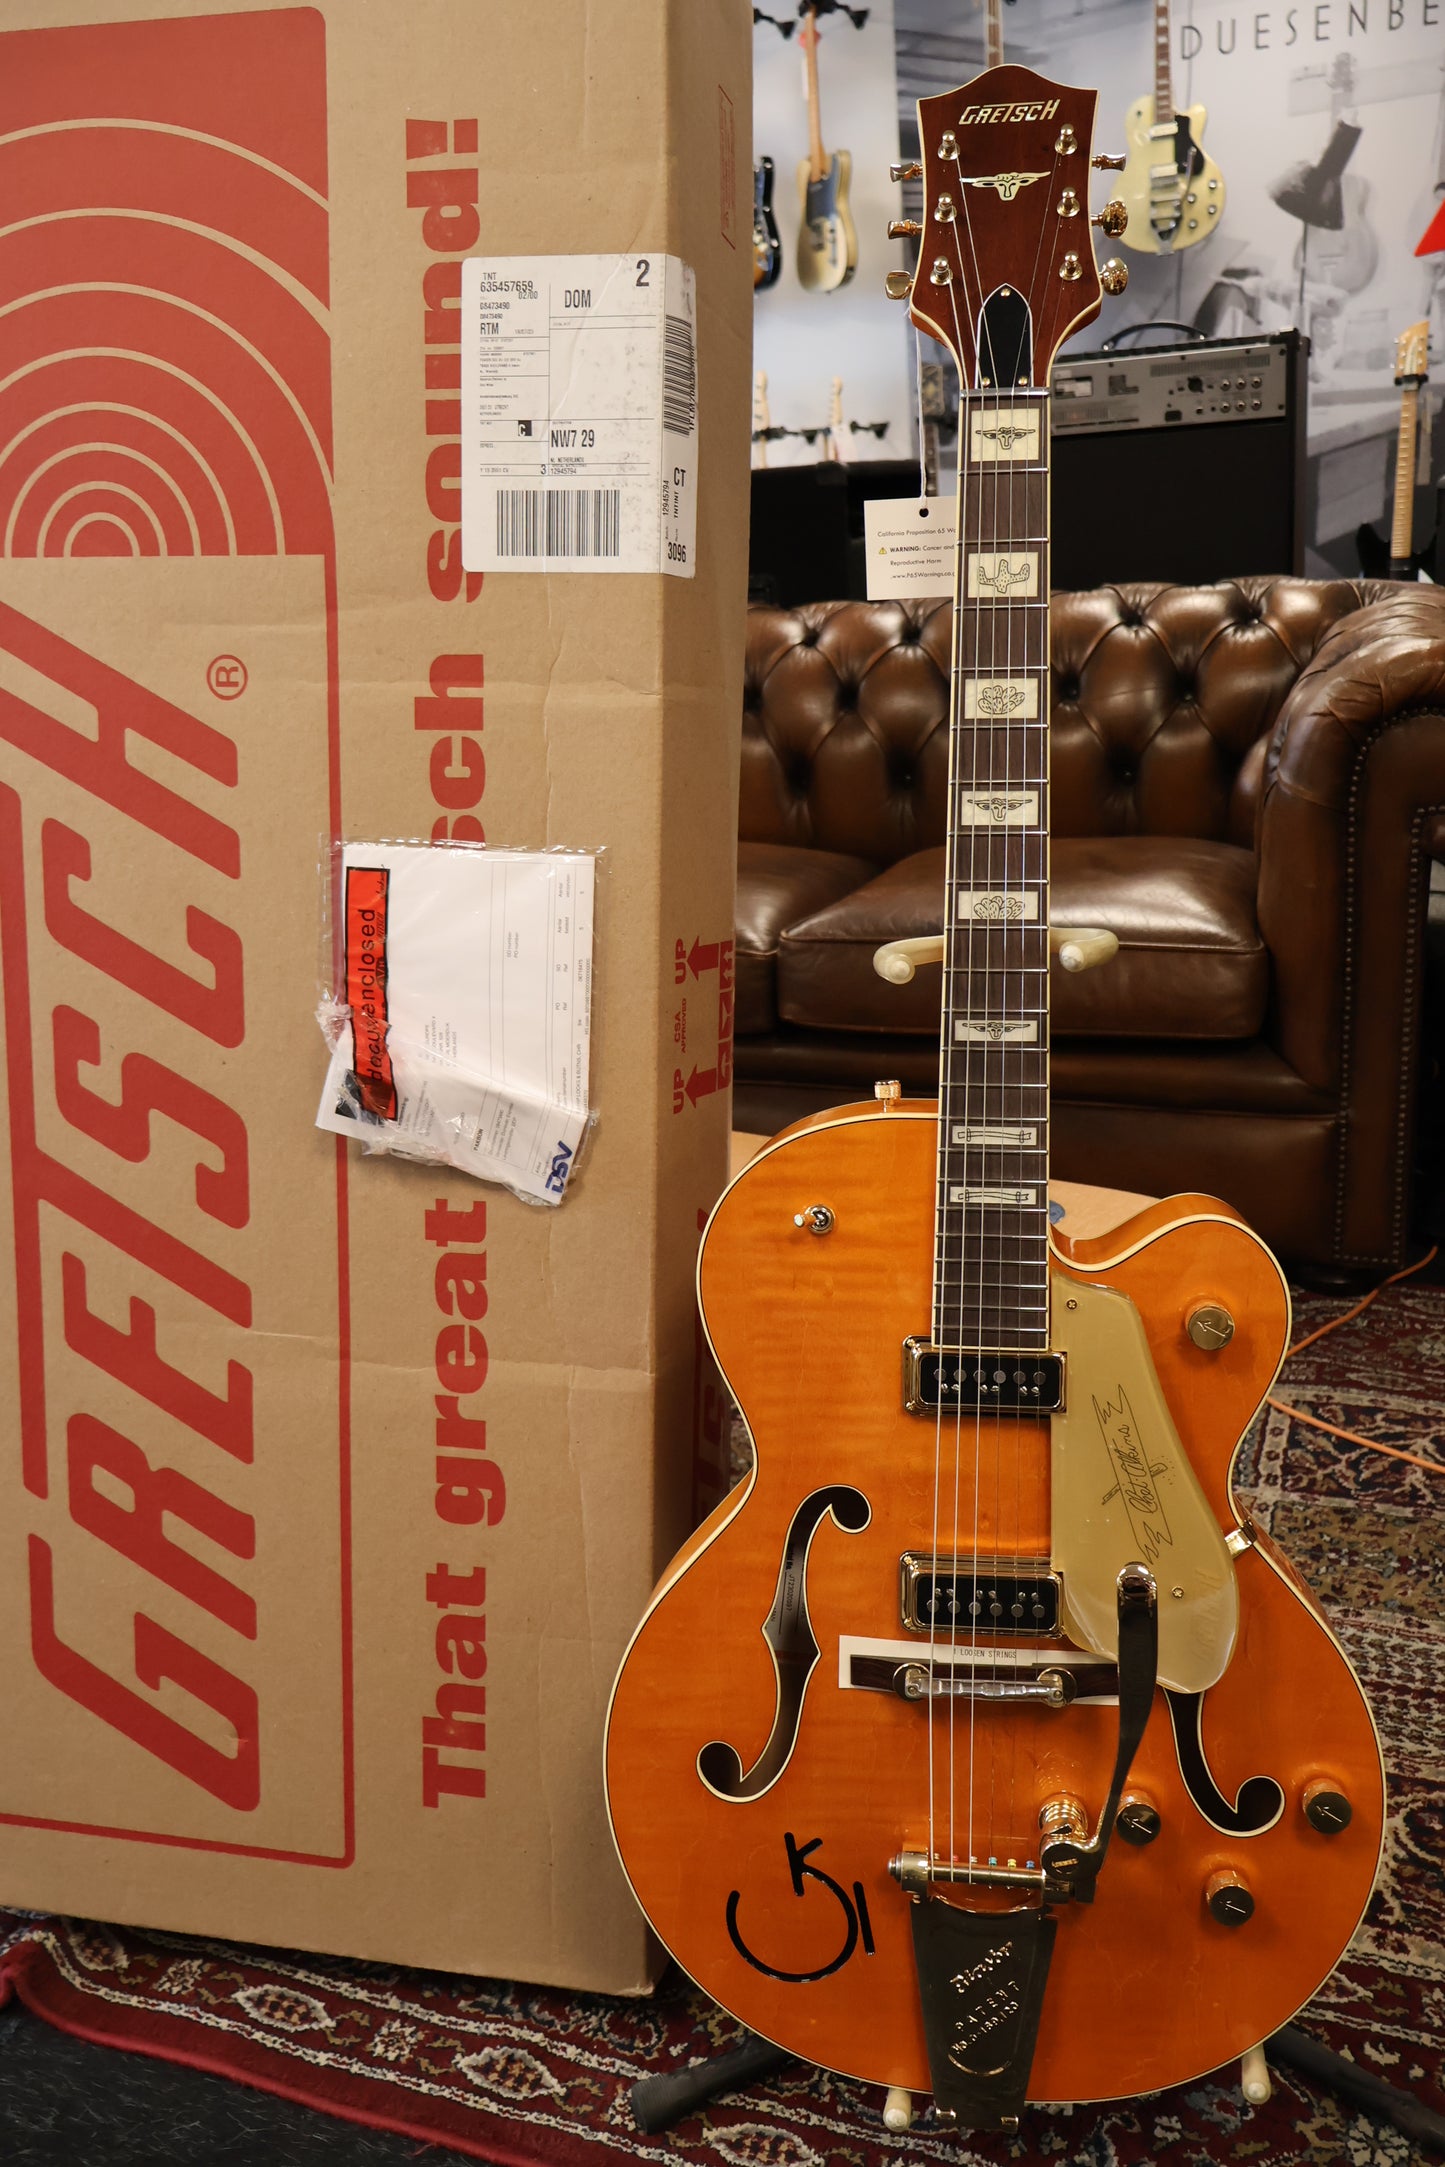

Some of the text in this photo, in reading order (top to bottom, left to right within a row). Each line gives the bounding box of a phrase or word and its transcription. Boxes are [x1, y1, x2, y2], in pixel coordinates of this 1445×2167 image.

[959, 99, 1060, 125] GRETSCH
[483, 272, 497, 280] TNT
[636, 259, 650, 287] 2
[480, 280, 534, 293] 635457659
[564, 289, 591, 308] DOM
[480, 322, 499, 336] RTM
[551, 429, 595, 448] NW7 29
[540, 464, 548, 475] 3
[674, 467, 686, 487] CT
[877, 530, 905, 538] California
[667, 541, 687, 563] 3096
[675, 938, 686, 984] UP
[673, 1068, 685, 1114] UP
[545, 1140, 572, 1193] DSV
[0, 603, 261, 1812] GRETSCH
[424, 1198, 506, 1527] great
[960, 1649, 985, 1657] LOOSEN
[422, 1562, 488, 1808] That
